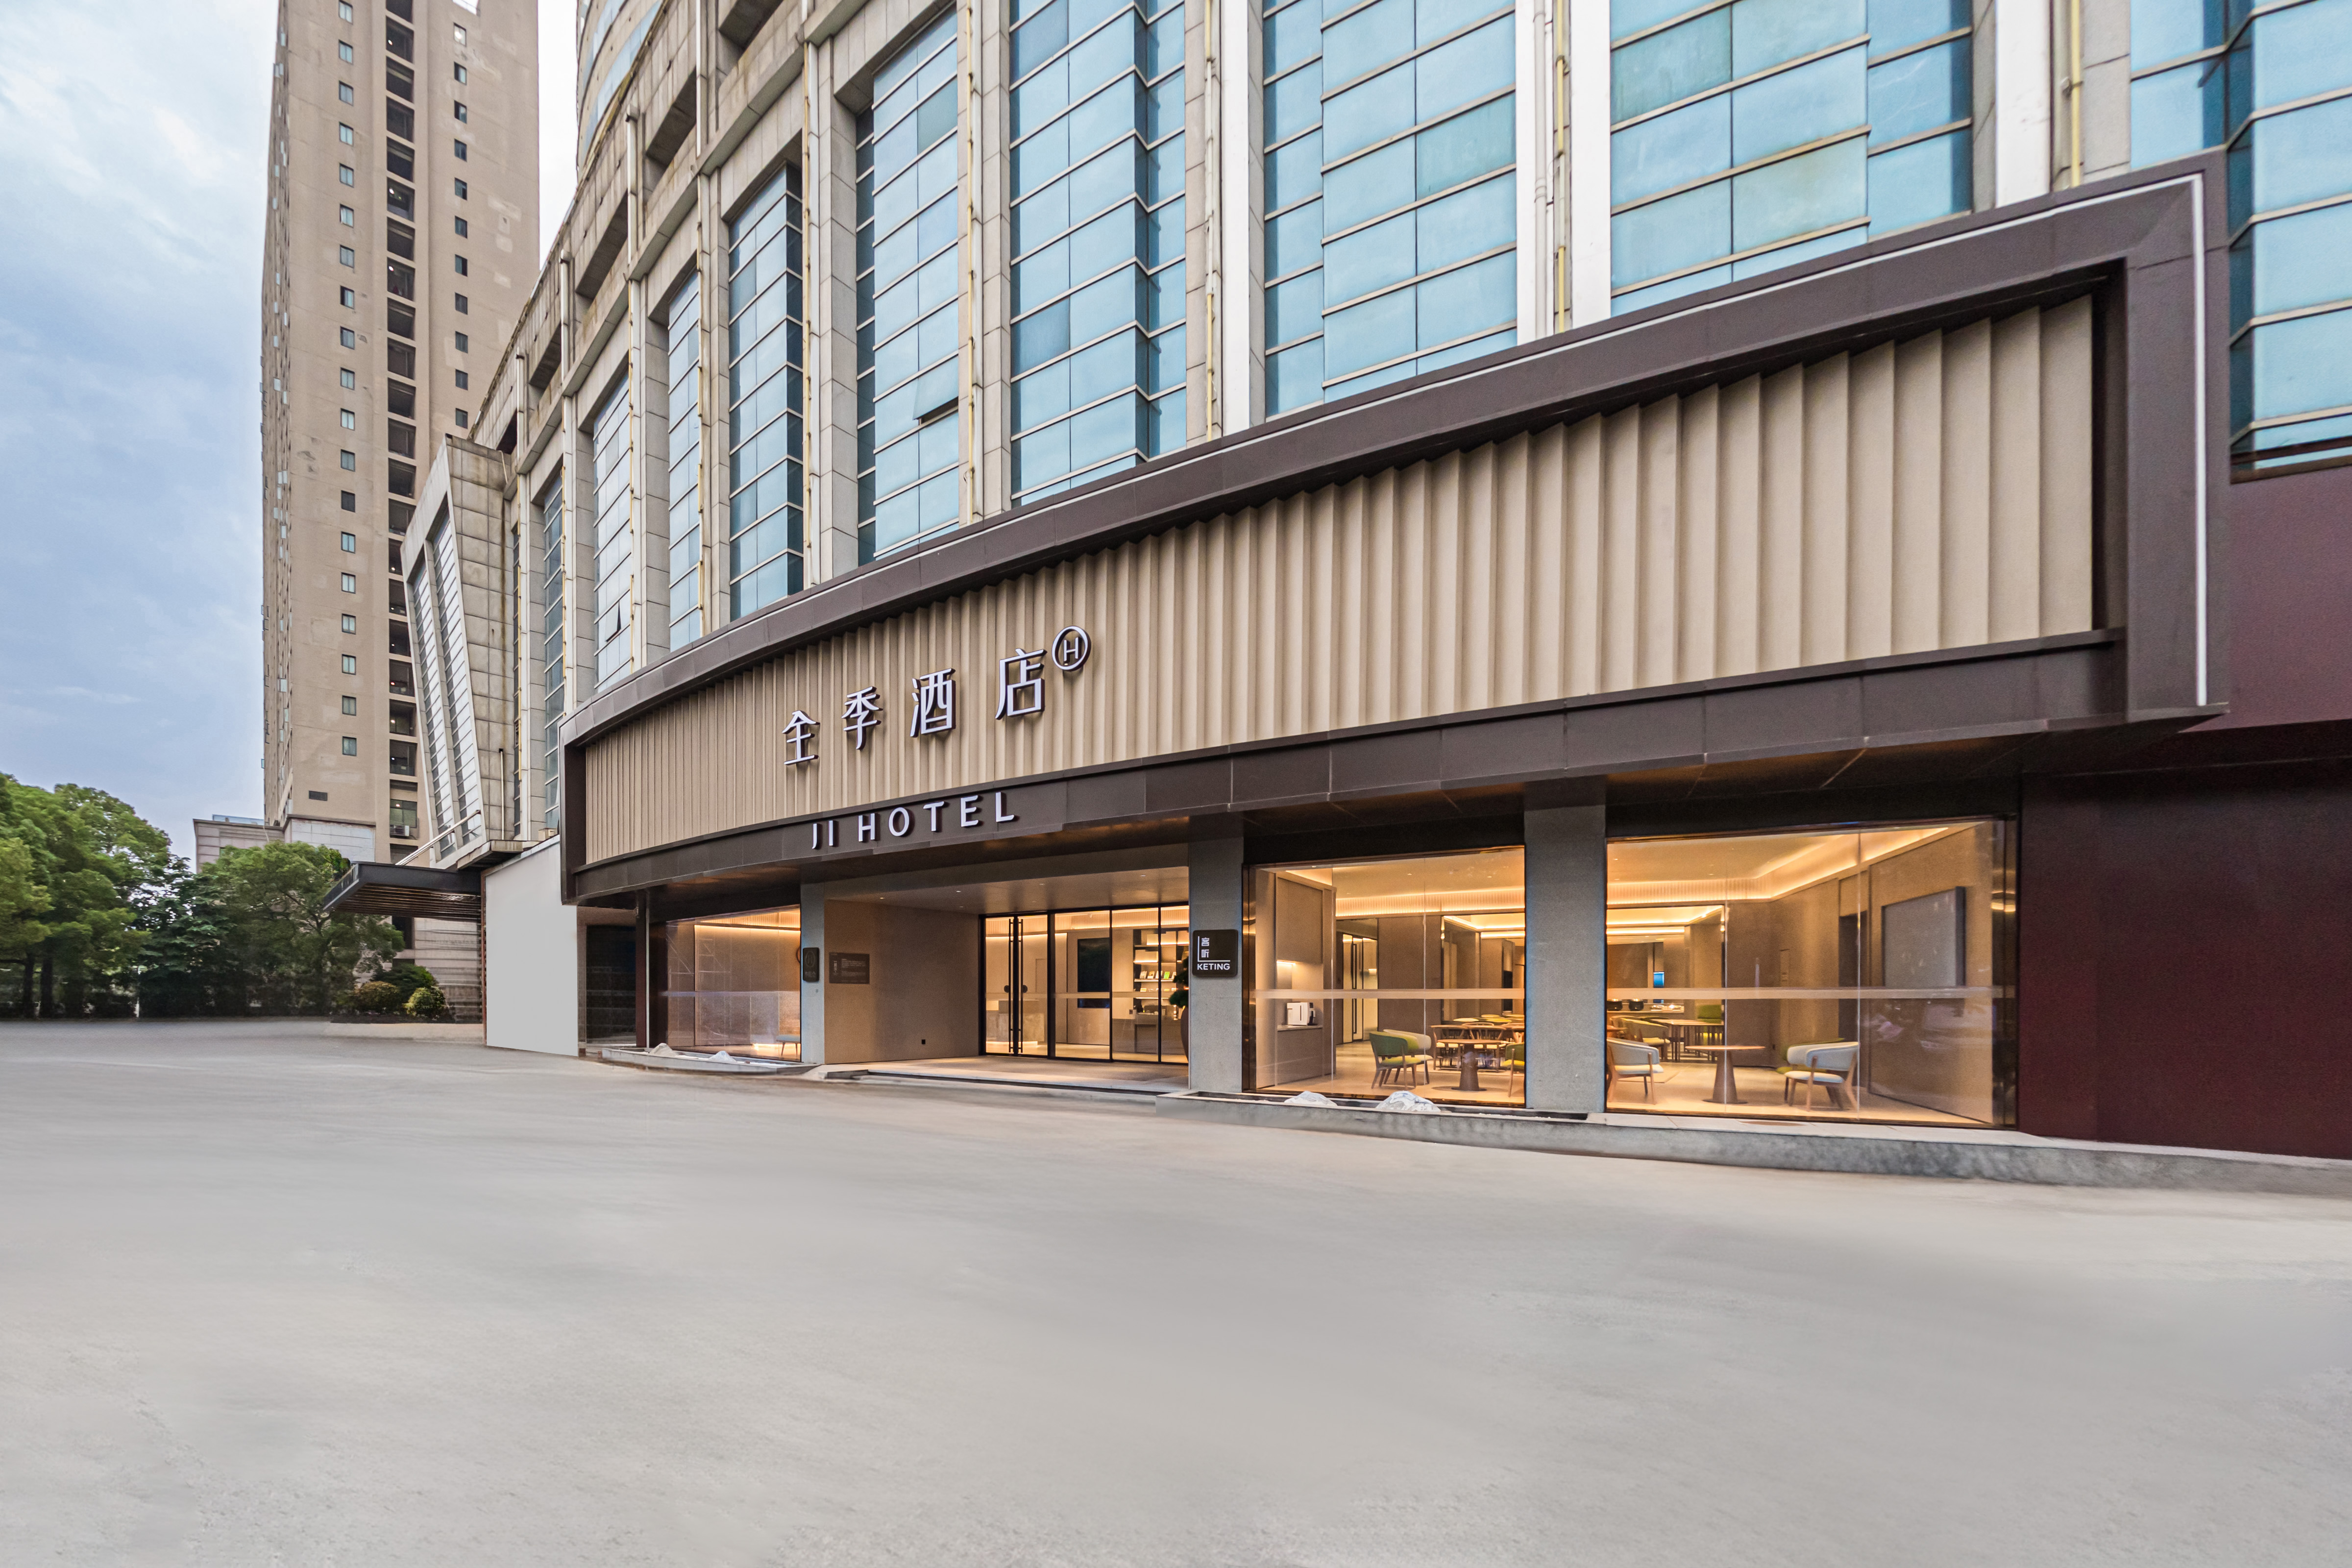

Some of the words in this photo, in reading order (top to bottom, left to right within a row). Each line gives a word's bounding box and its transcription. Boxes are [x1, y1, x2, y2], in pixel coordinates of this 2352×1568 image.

[782, 648, 1047, 765] 全季酒店
[811, 820, 833, 849] JI
[858, 792, 1015, 842] HOTEL
